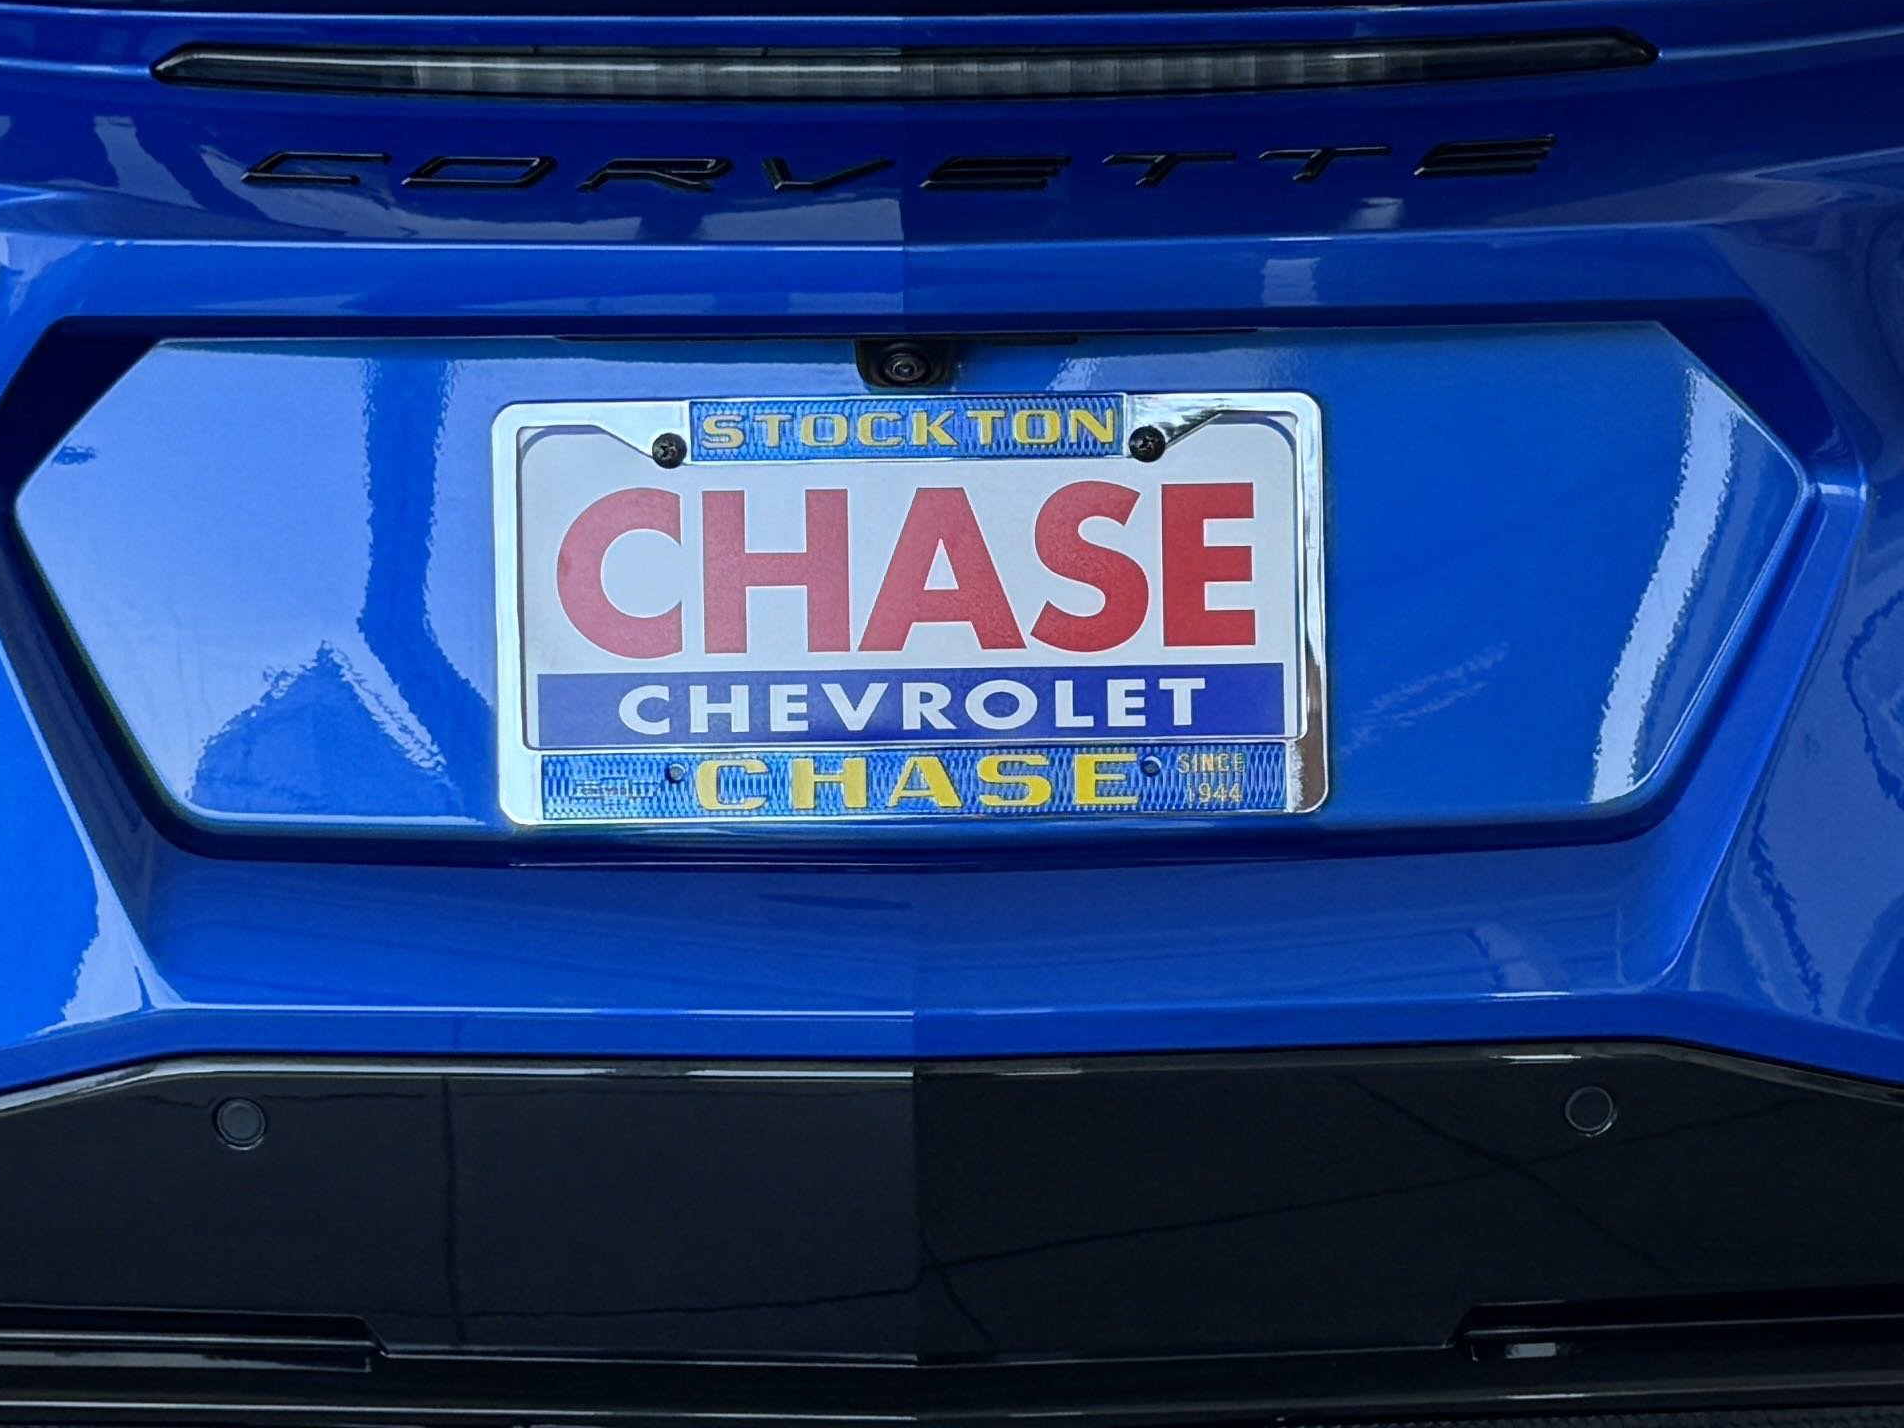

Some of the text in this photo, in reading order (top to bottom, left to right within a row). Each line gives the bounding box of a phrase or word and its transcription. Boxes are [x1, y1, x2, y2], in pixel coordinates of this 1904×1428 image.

[241, 134, 1558, 192] CORVETTE
[701, 407, 1115, 450] STOCKTON
[555, 480, 1257, 660] CHASE
[617, 677, 1206, 736] CHEVROLET
[695, 752, 1139, 812] CHASE
[1177, 752, 1245, 774] SINCE
[1186, 782, 1243, 803] 1944
